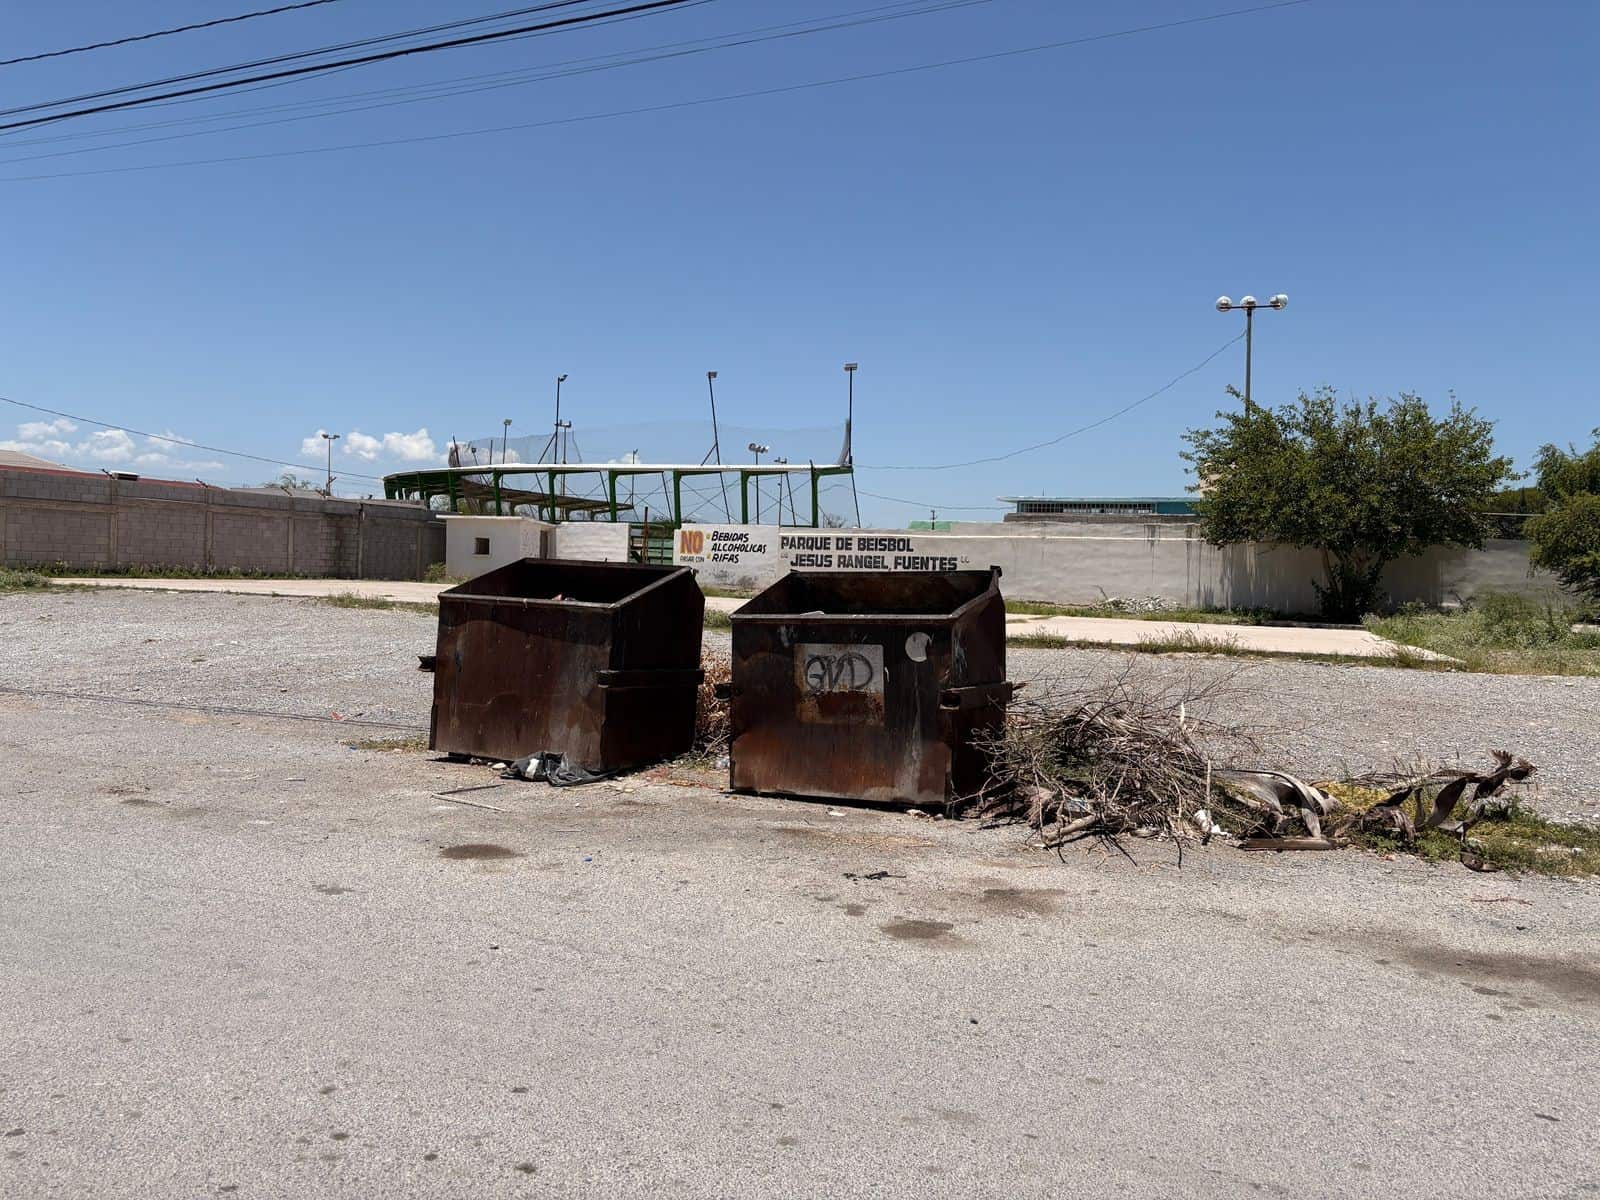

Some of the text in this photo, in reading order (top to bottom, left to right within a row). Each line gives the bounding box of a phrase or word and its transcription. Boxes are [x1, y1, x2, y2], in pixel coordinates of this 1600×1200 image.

[680, 530, 704, 554] NO
[711, 531, 749, 543] BEBIDAS
[711, 543, 767, 554] ALCOHOLICAS
[781, 536, 914, 552] PARQUE DE BEISBOL
[711, 553, 739, 564] RIFAS
